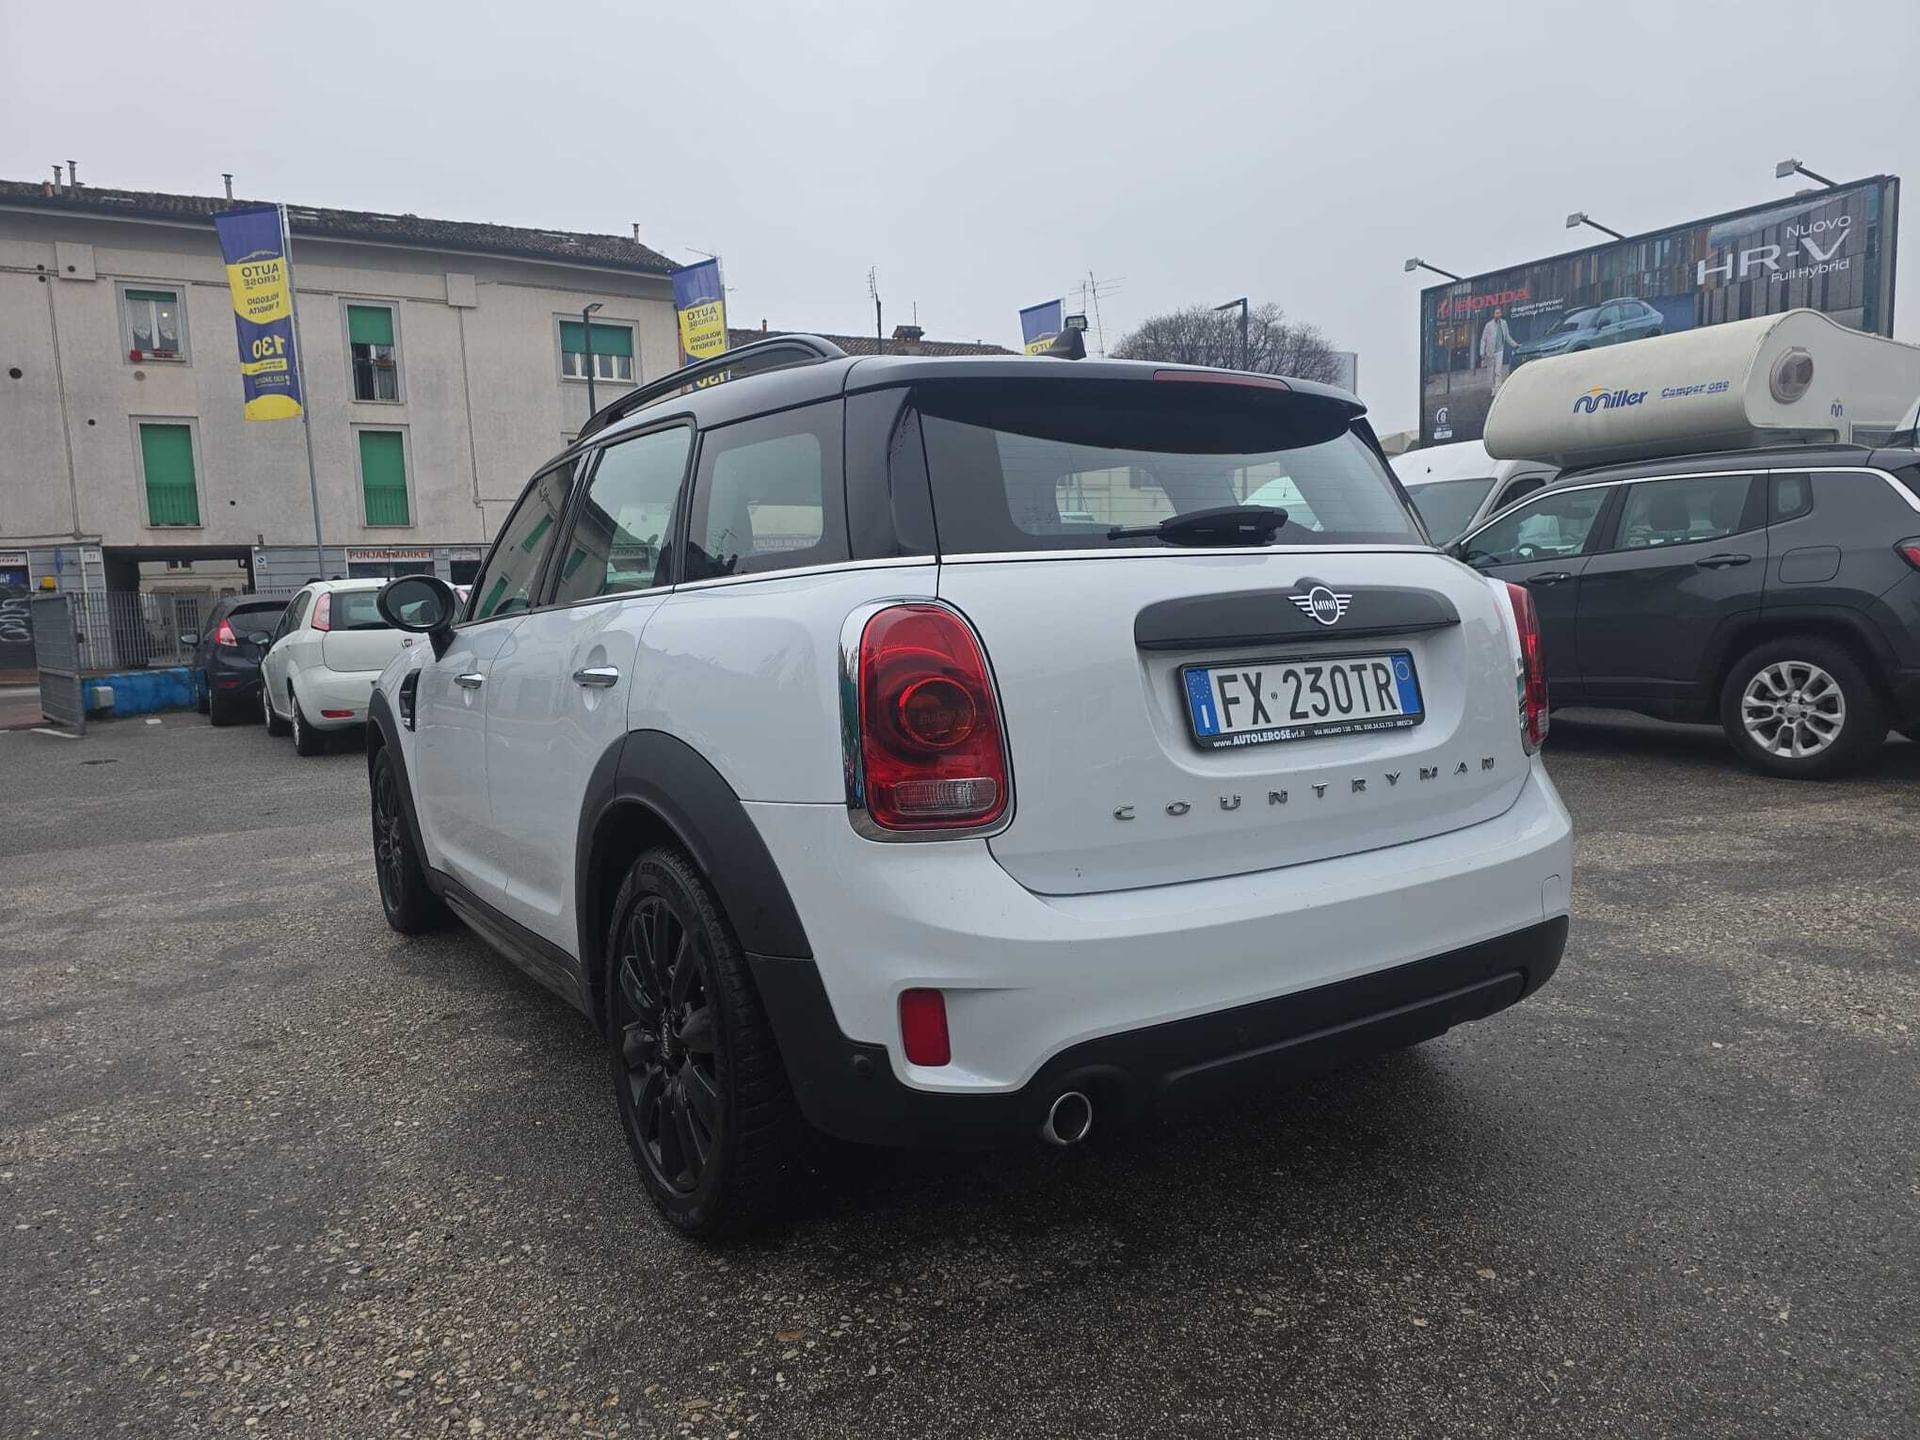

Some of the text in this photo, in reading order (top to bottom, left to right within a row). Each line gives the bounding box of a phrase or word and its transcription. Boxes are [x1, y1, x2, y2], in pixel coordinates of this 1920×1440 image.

[1787, 215, 1851, 239] Nuovo
[1697, 228, 1850, 285] HR-V
[1771, 258, 1850, 283] Full Hybrid
[1455, 288, 1531, 312] HONDA
[1662, 380, 1730, 397] Camper one
[1573, 390, 1648, 414] Miller
[349, 550, 433, 560] PUNJAB MARKET
[1313, 600, 1336, 610] MINI
[1217, 662, 1398, 728] FX 230TR
[1113, 756, 1494, 820] COUNTRYMAN
